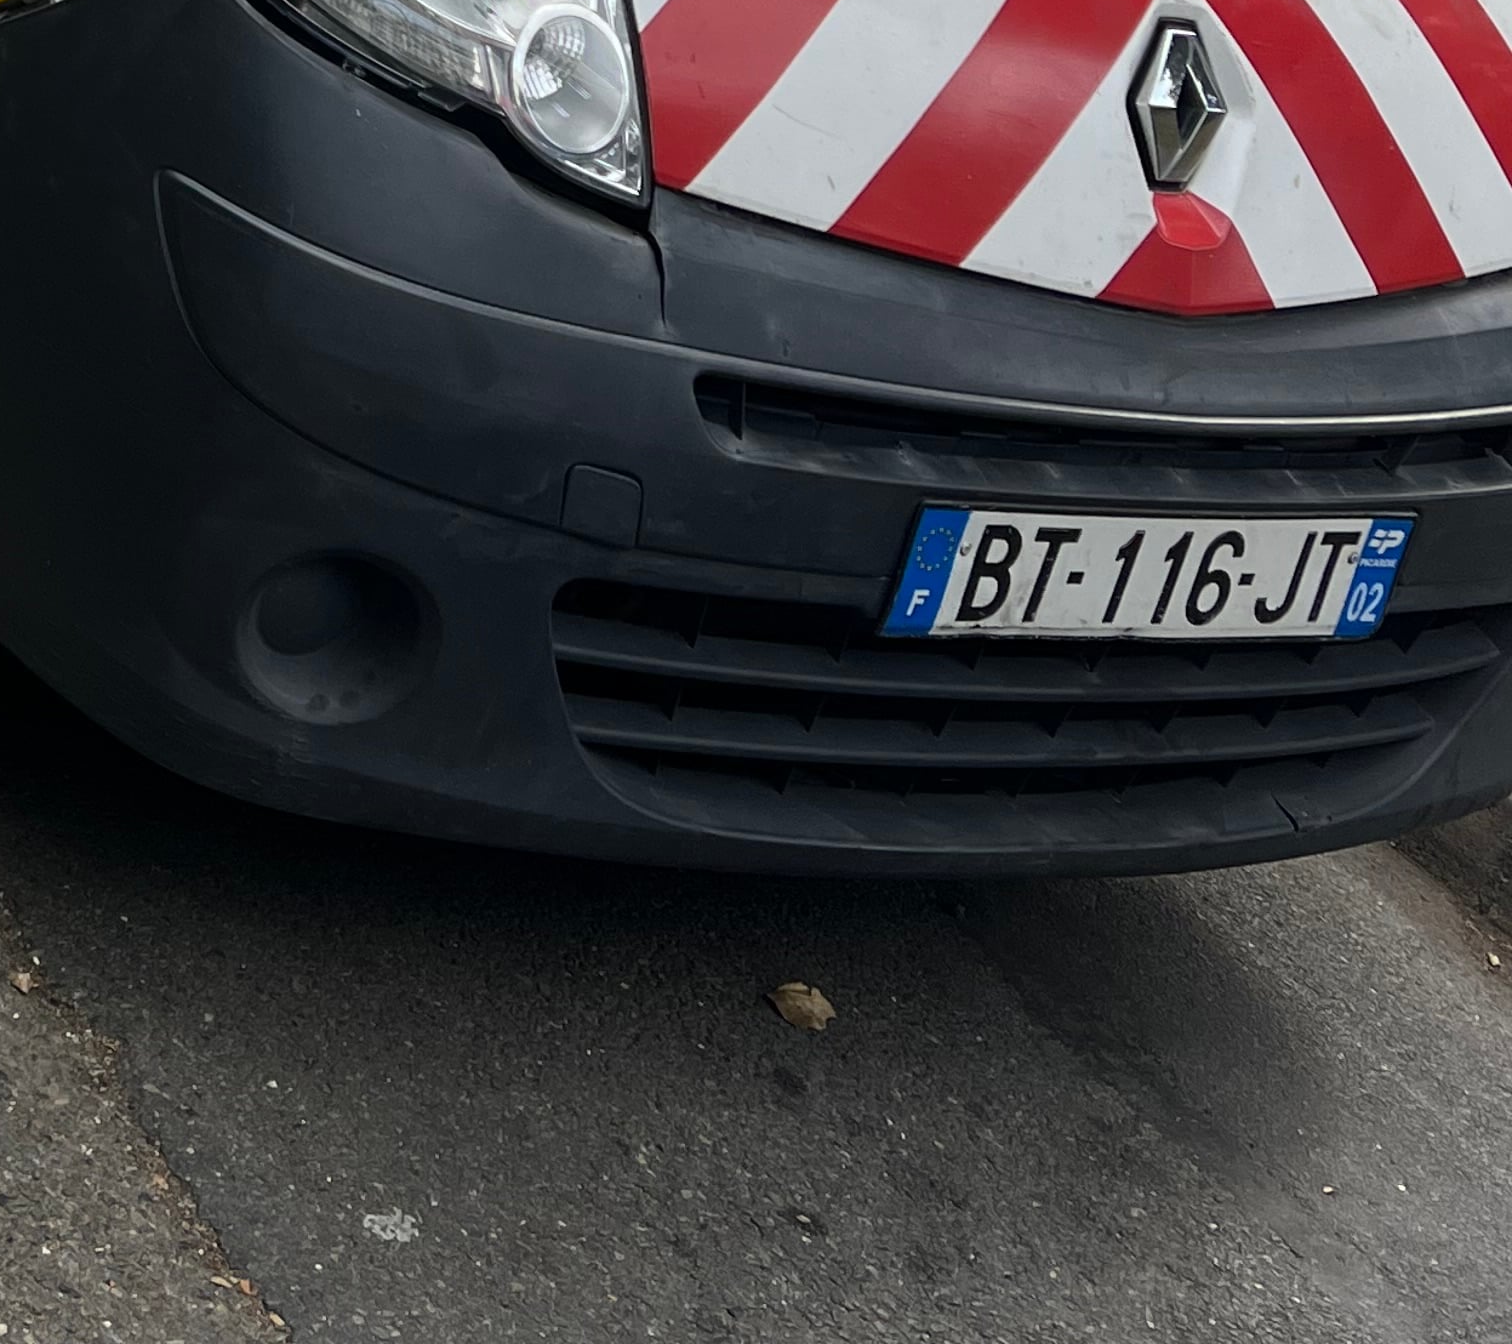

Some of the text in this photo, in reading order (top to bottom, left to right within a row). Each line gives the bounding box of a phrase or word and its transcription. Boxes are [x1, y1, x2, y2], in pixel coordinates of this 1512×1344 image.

[955, 524, 1362, 626] BT-116-JT
[906, 589, 930, 616] F
[1346, 581, 1385, 623] 02
